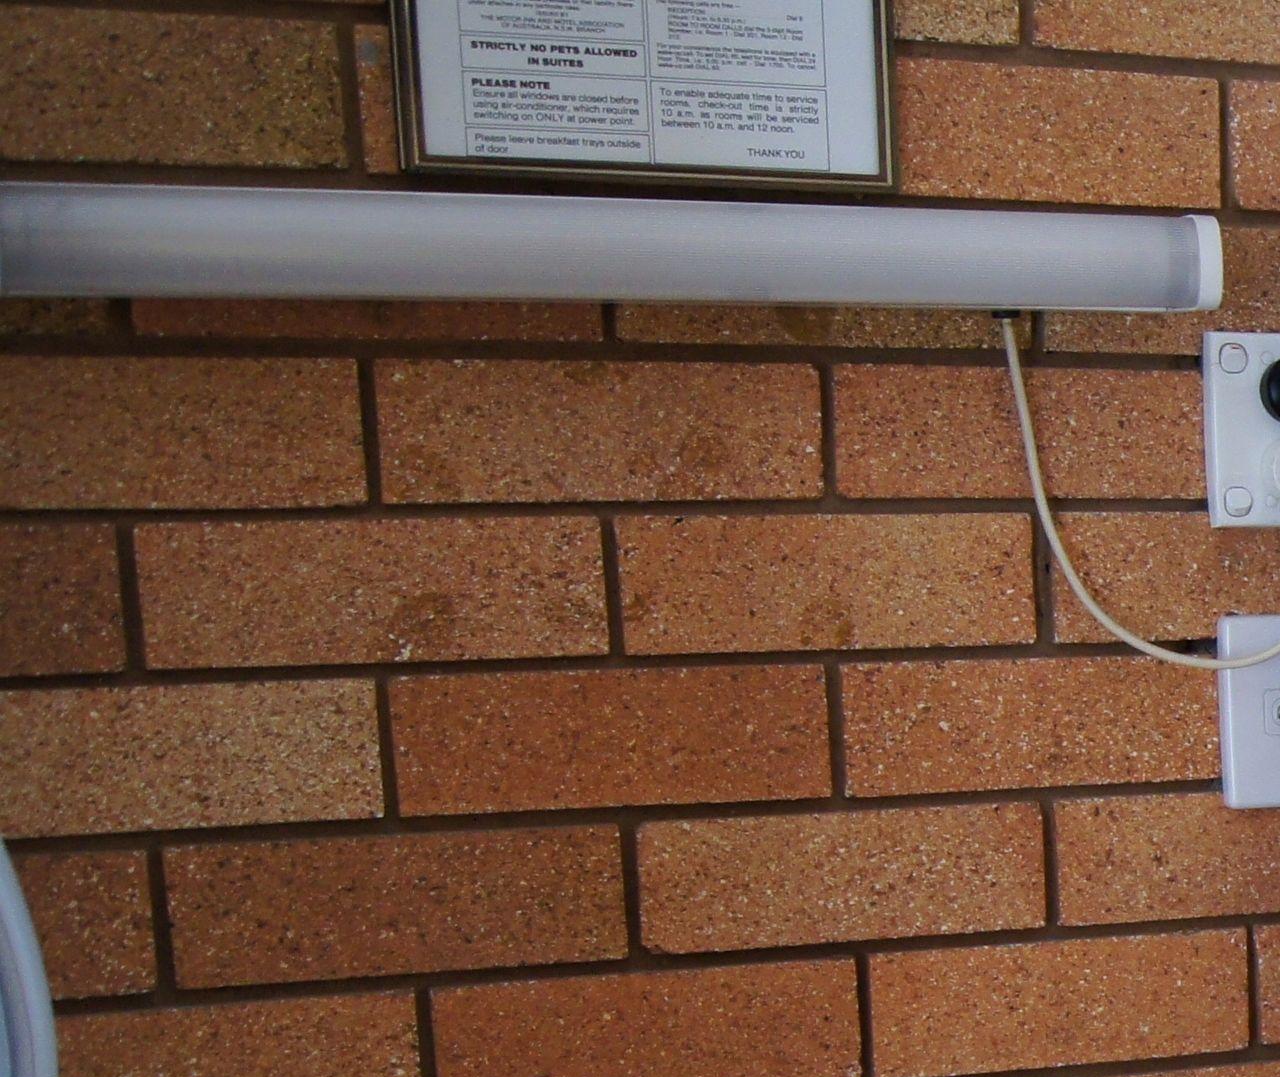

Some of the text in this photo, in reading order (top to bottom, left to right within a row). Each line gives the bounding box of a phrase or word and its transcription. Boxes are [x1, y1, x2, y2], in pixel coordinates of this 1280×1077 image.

[471, 41, 637, 58] STRICTLY NO PETS ALLOWED
[528, 57, 584, 68] IN SUITES
[471, 78, 550, 90] PLEASE NOTE
[472, 89, 638, 105] Ensure all windows are closed before
[660, 87, 819, 105] To enable adequate time to service
[473, 100, 499, 110] using
[573, 104, 600, 114] which
[602, 106, 640, 117] requires
[698, 100, 743, 111] check-out
[749, 103, 769, 112] time
[775, 103, 783, 113] is
[789, 104, 819, 116] strictly
[474, 110, 518, 121] switching
[521, 113, 533, 121] on
[536, 112, 564, 123] ONLY
[567, 114, 576, 123] at
[579, 117, 607, 126] power
[661, 108, 673, 118] 10
[715, 112, 743, 121] rooms
[746, 112, 762, 122] will
[766, 114, 778, 123] be
[782, 115, 820, 125] serviced
[661, 118, 700, 129] between
[703, 120, 715, 130] 10
[737, 122, 755, 132] and
[758, 123, 768, 132] 12
[475, 132, 641, 150] Please leave breakfast trays outside
[747, 147, 805, 160] THANK YOU
